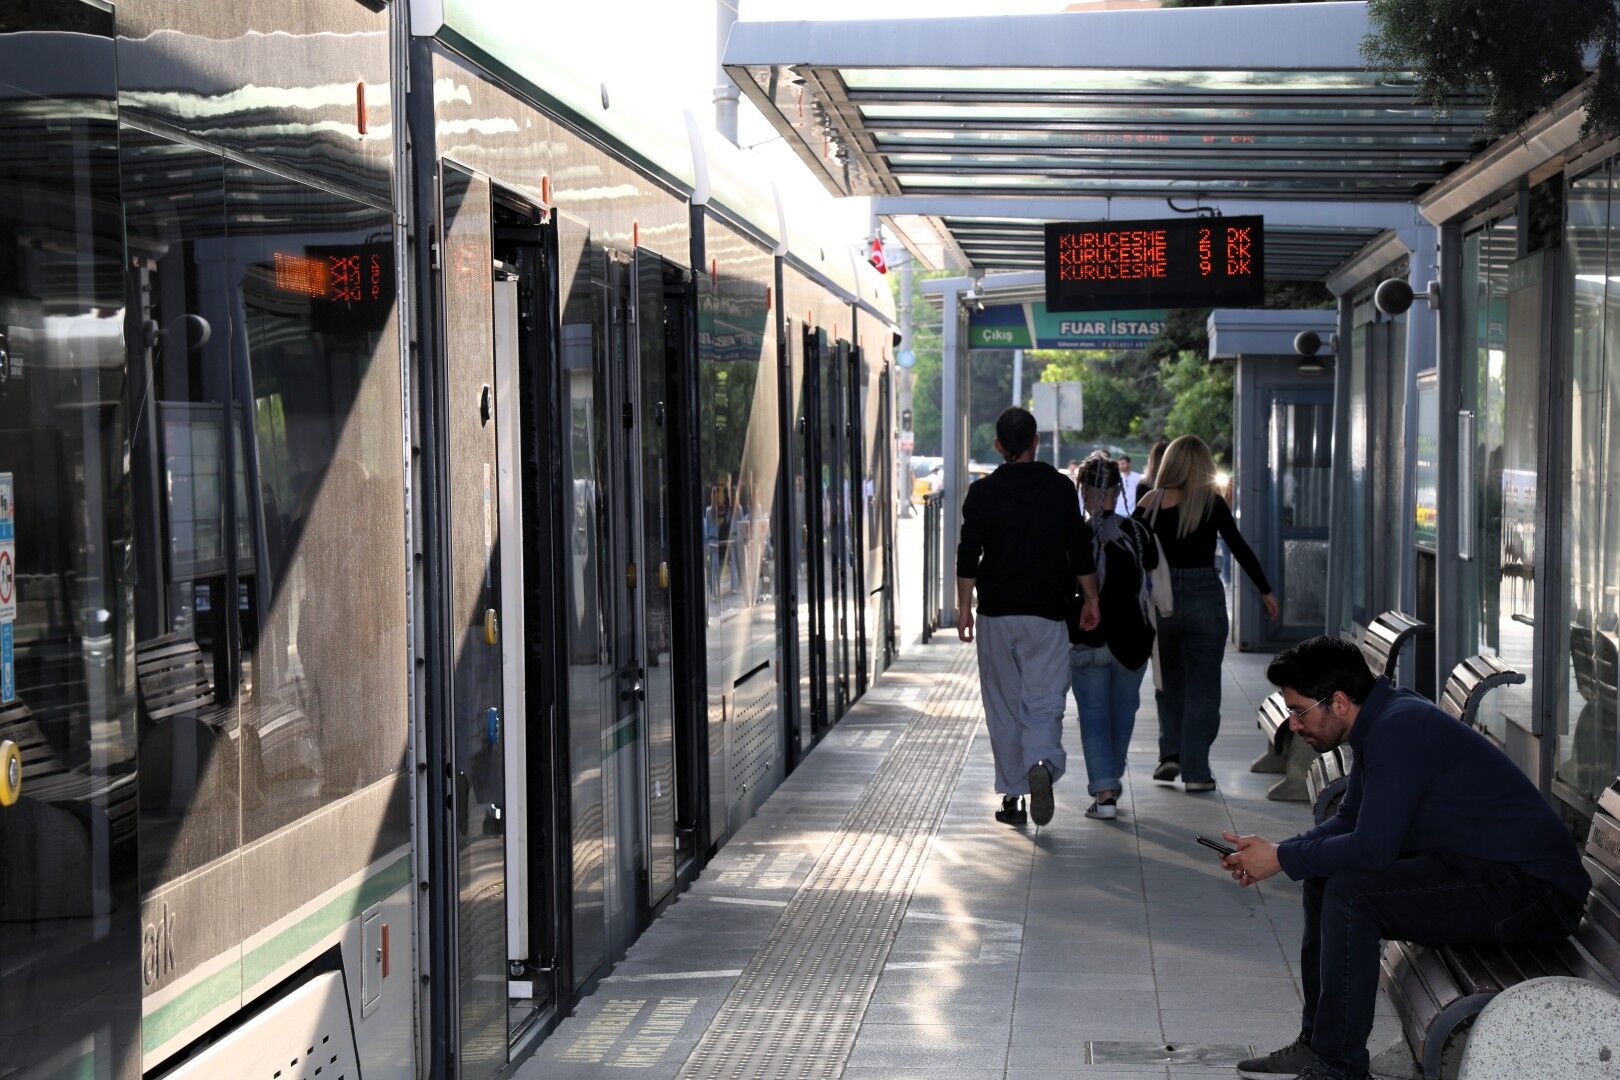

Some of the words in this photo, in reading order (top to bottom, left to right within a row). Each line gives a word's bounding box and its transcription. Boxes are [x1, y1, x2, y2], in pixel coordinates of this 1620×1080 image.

[1060, 230, 1166, 249] KURUCESME
[1199, 229, 1211, 244] 2
[1227, 227, 1251, 243] DK
[1060, 246, 1167, 265] KURUCESME
[1199, 244, 1211, 259] 5
[1227, 243, 1251, 259] DK
[1060, 262, 1167, 280] KURUCESME
[1199, 260, 1211, 276] 9
[1227, 259, 1251, 275] DK
[982, 328, 1013, 342] Çıkış
[1060, 321, 1106, 335] FUAR
[1111, 319, 1167, 335] İSTAS
